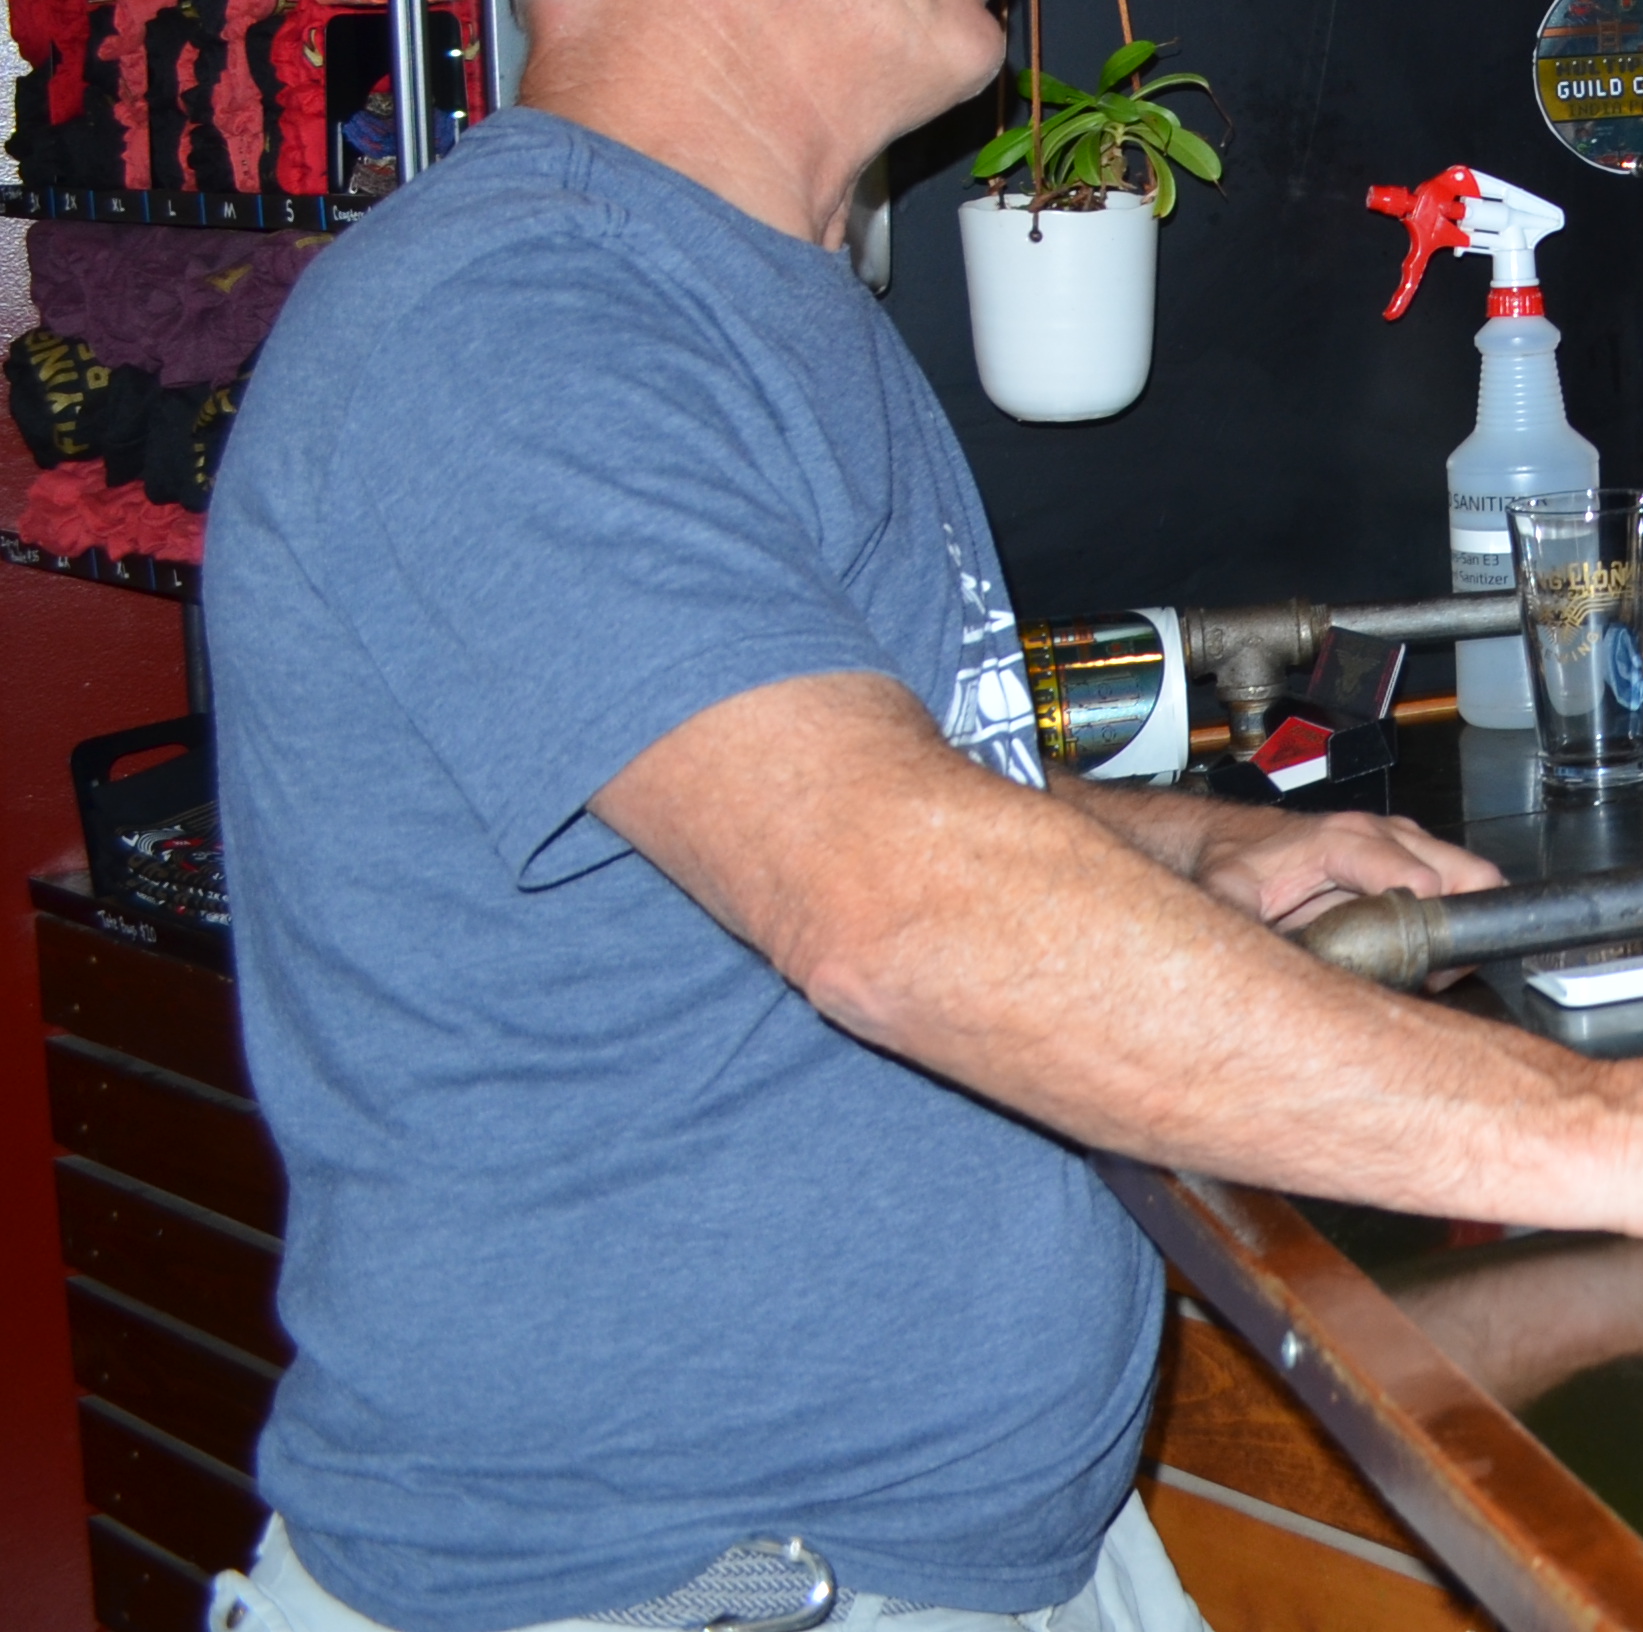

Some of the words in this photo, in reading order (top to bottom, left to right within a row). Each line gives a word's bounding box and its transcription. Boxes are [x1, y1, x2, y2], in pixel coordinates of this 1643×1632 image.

[1557, 77, 1622, 100] GUILD
[112, 198, 125, 212] XL
[168, 201, 177, 217] L
[224, 202, 236, 219] M
[286, 200, 294, 222] S
[1484, 554, 1499, 566] E3
